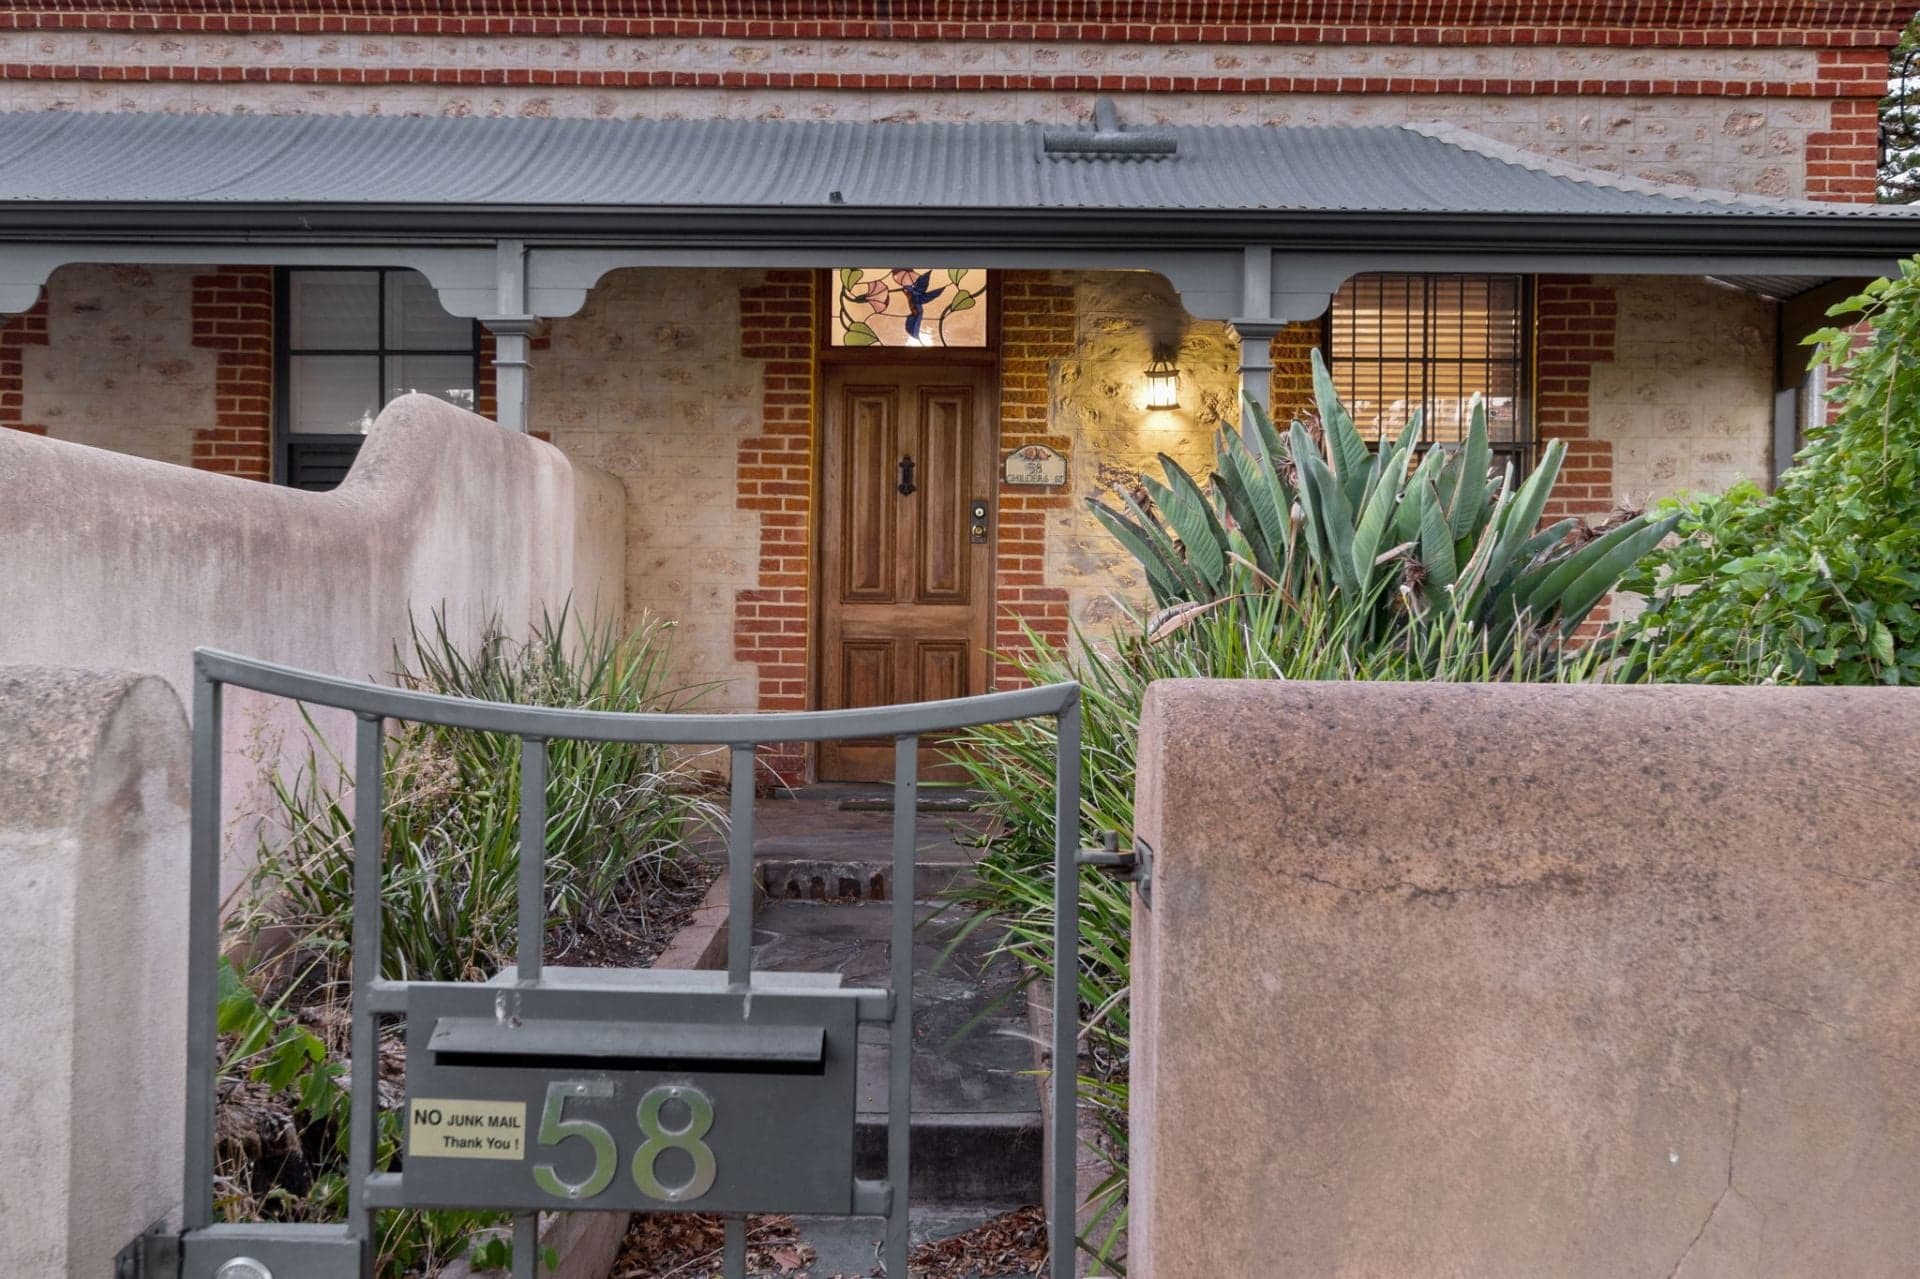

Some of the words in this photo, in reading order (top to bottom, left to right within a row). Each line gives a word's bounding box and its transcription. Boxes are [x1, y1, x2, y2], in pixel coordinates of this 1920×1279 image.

[414, 1109, 442, 1126] NO
[447, 1114, 484, 1127] JUNK
[488, 1115, 521, 1128] MAIL
[443, 1135, 483, 1149] Thank
[486, 1136, 511, 1150] You
[533, 1080, 717, 1201] 58
